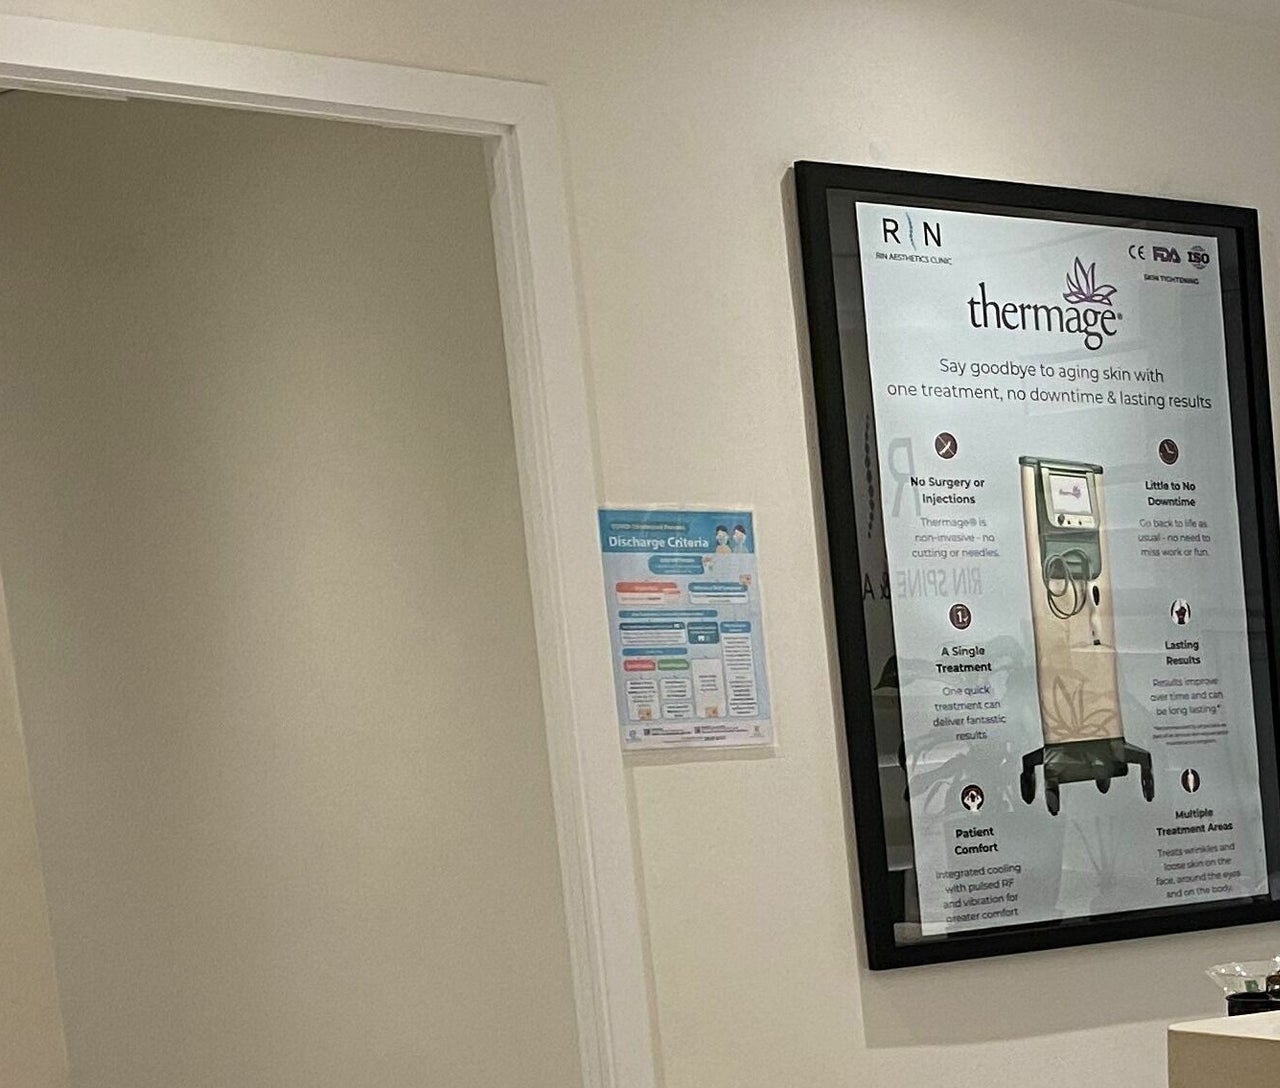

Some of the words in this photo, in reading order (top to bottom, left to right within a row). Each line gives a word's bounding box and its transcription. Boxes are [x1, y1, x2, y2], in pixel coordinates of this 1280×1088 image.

[876, 252, 888, 260] RIN
[889, 253, 929, 264] AESTHETICS
[930, 256, 952, 266] CLINIC
[1152, 246, 1181, 263] FDA
[1187, 251, 1210, 265] ISO
[939, 358, 966, 378] Say
[970, 361, 1036, 379] goodbye
[1040, 364, 1054, 377] to
[1058, 366, 1099, 382] aging
[1103, 366, 1131, 381] skin
[1135, 367, 1164, 383] with
[887, 384, 917, 396] one
[921, 384, 1004, 402] treatment,
[1007, 389, 1026, 401] no
[1029, 388, 1103, 404] downtime
[1107, 391, 1117, 404] &
[1119, 392, 1165, 410] lasting
[1168, 394, 1212, 409] results
[911, 476, 926, 487] No
[929, 477, 970, 489] Surgery
[973, 480, 985, 488] or
[1145, 481, 1169, 491] Little
[1171, 482, 1181, 491] to
[1182, 482, 1196, 491] No
[922, 493, 976, 505] Injections
[1148, 497, 1196, 507] Downtime
[979, 518, 987, 527] is
[1139, 519, 1151, 528] Go
[1153, 519, 1173, 528] back
[1175, 520, 1183, 528] to
[1185, 519, 1197, 528] life
[608, 536, 666, 550] Discharge
[667, 537, 709, 548] Criteria
[915, 533, 975, 542] non-invasive
[982, 534, 996, 542] no
[1138, 533, 1161, 542] usual
[1180, 534, 1201, 542] need
[1202, 534, 1210, 542] to
[912, 548, 948, 559] cutting
[949, 549, 960, 558] or
[1141, 548, 1160, 556] miss
[1162, 548, 1182, 556] work
[1165, 640, 1199, 651] Lasting
[941, 647, 950, 656] A
[952, 646, 985, 657] Single
[1166, 655, 1200, 666] Results
[936, 663, 992, 673] Treatment
[1153, 678, 1182, 687] Results
[942, 686, 963, 695] One
[964, 686, 991, 696] quick
[1150, 693, 1168, 702] over
[1169, 692, 1189, 701] time
[1191, 691, 1207, 700] and
[1208, 691, 1224, 699] can
[934, 702, 982, 711] treatment
[984, 702, 1000, 710] can
[1156, 707, 1167, 716] be
[1169, 706, 1187, 716] long
[933, 717, 964, 727] deliver
[966, 715, 1006, 725] fantastic
[1175, 808, 1213, 819] Multiple
[955, 827, 994, 839] Patient
[1156, 825, 1205, 837] Treatment
[1207, 822, 1233, 832] Areas
[954, 843, 999, 855] Comfort
[1157, 848, 1183, 858] Treats
[1184, 845, 1218, 856] wrinkles
[1219, 843, 1235, 851] and
[1164, 862, 1185, 871] loose
[1187, 860, 1204, 869] skin
[1205, 860, 1216, 868] on
[1217, 857, 1232, 866] the
[936, 866, 985, 880] Integrated
[986, 864, 1022, 874] cooling
[1177, 874, 1206, 885] around
[1207, 872, 1221, 881] the
[1222, 870, 1241, 880] eyes
[945, 883, 966, 893] with
[968, 881, 1000, 892] pulsed
[1001, 878, 1014, 888] RF
[1166, 889, 1182, 899] and
[1183, 889, 1195, 897] on
[1196, 885, 1210, 894] the
[943, 899, 962, 909] and
[963, 895, 1005, 907] vibration
[1006, 893, 1018, 901] for
[946, 912, 980, 923] greater
